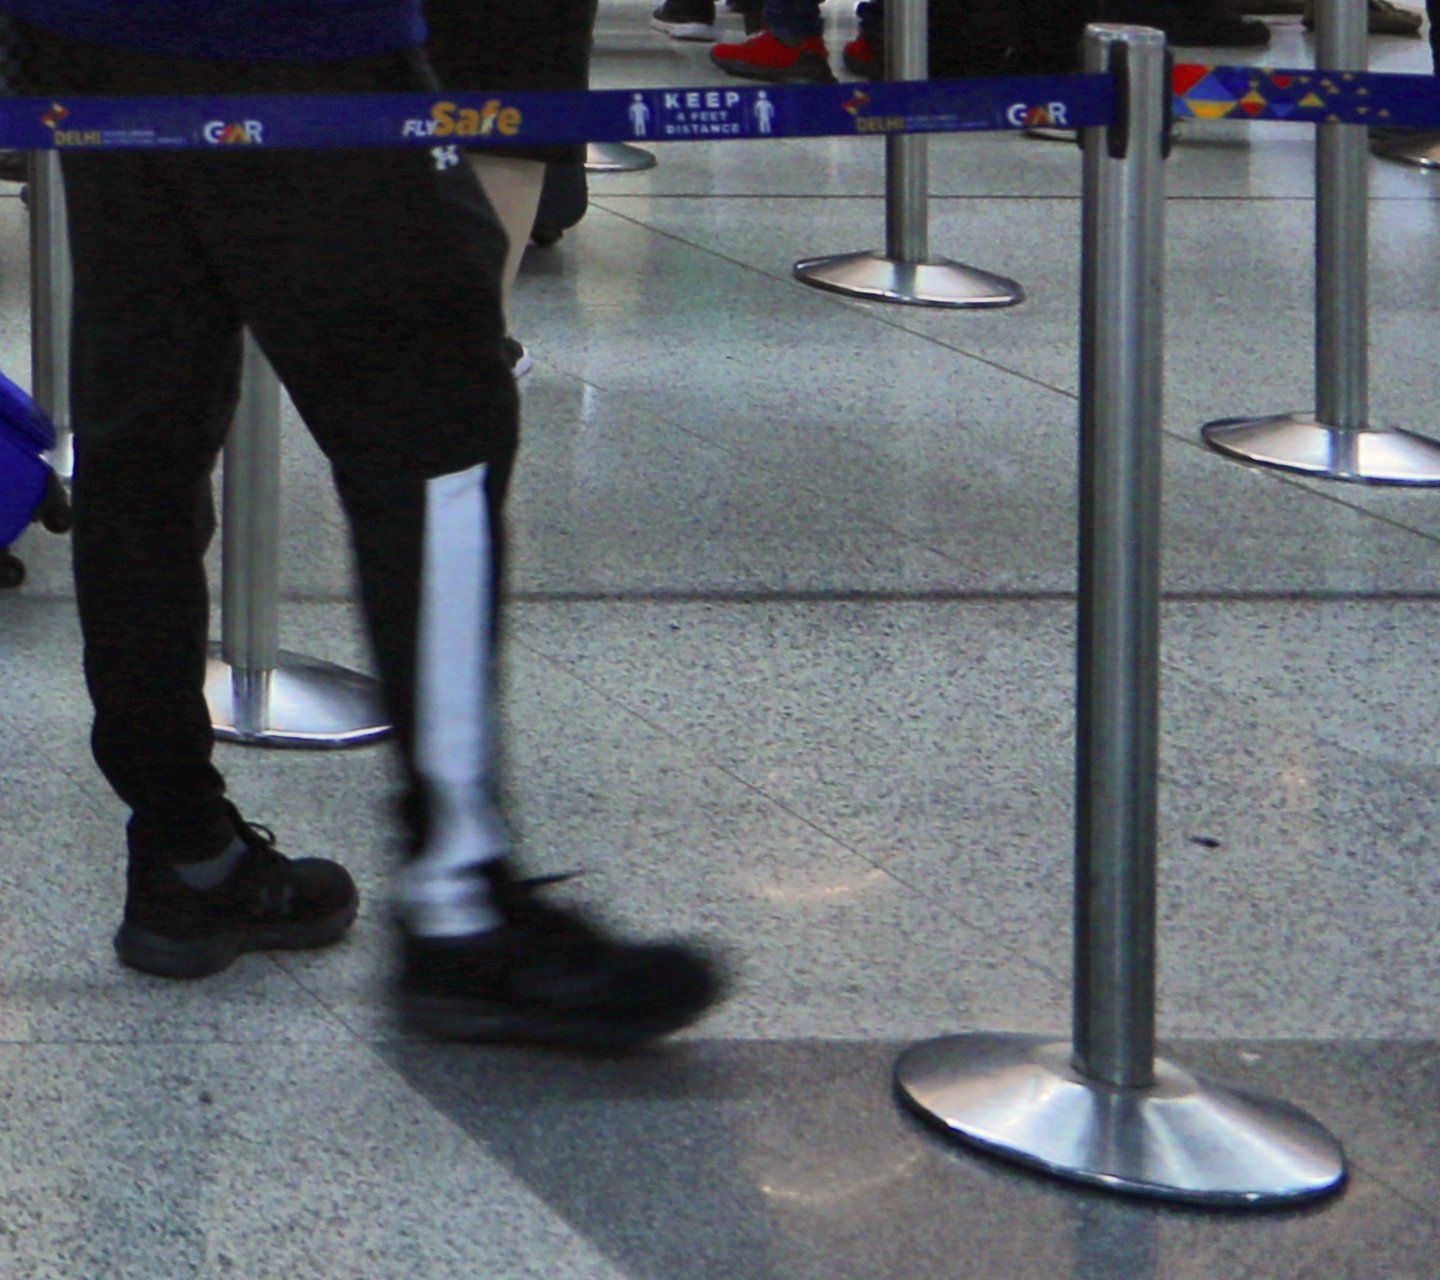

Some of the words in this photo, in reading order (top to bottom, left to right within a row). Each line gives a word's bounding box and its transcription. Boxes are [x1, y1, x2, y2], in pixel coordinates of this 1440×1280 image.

[664, 92, 740, 109] KEEP
[857, 116, 904, 132] DELHI
[1007, 102, 1067, 126] GMR
[204, 121, 263, 144] GMR
[666, 123, 740, 134] DISTANCE
